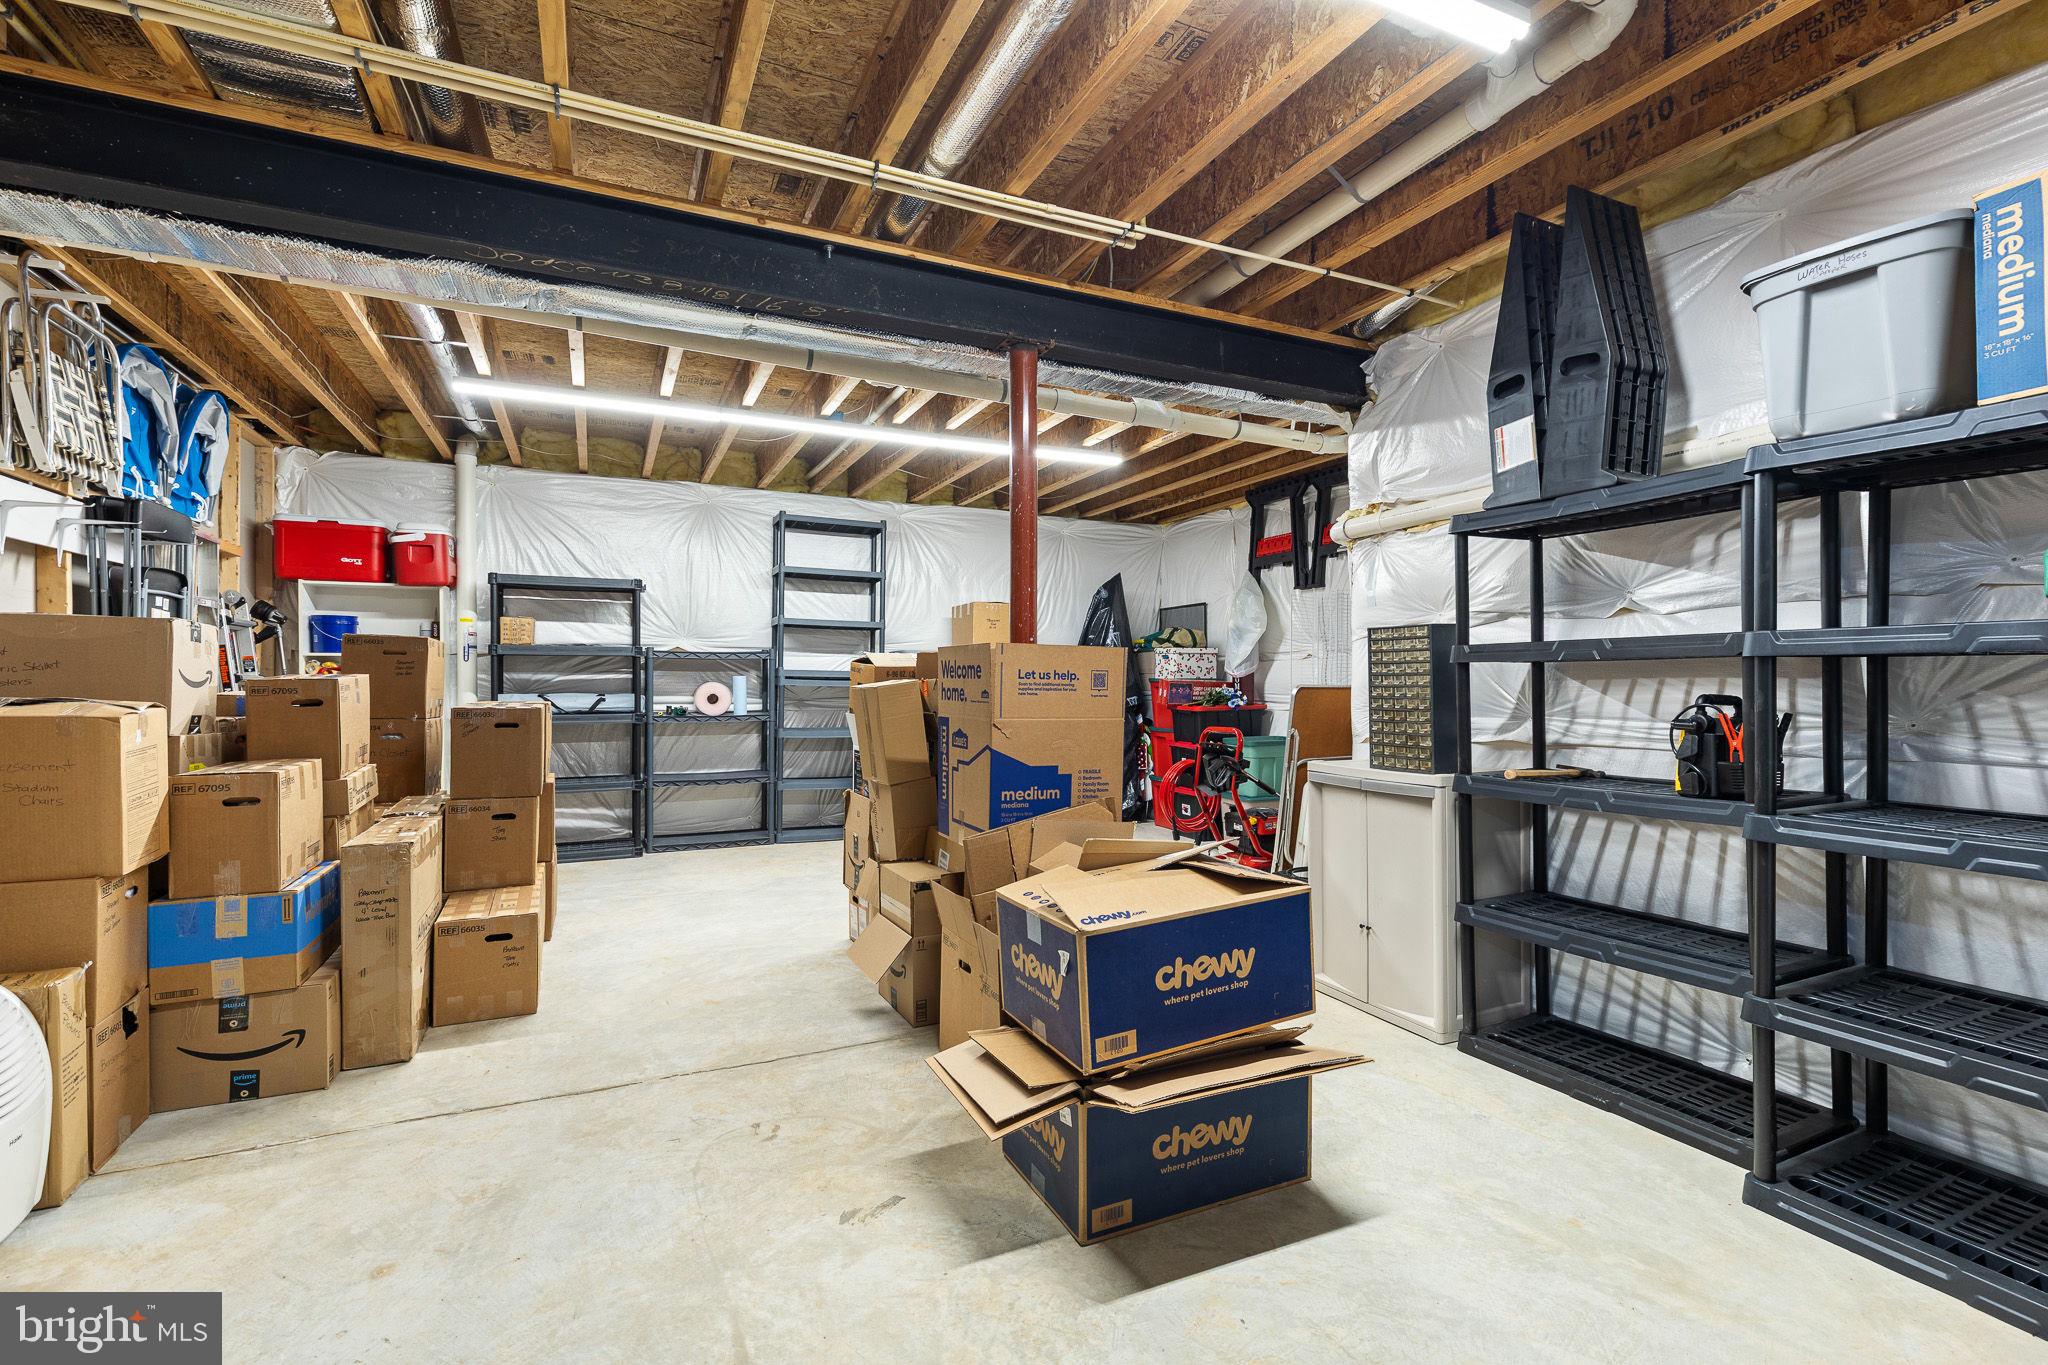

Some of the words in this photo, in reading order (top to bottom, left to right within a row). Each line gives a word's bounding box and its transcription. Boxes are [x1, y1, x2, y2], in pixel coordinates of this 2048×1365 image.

[1626, 96, 1674, 142] 210
[1982, 213, 1993, 260] mediana
[1996, 201, 2036, 337] medium
[941, 659, 982, 680] Welcome
[1018, 668, 1036, 681] Let
[1039, 671, 1051, 681] us
[1053, 669, 1080, 683] help.
[271, 687, 298, 695] 67095
[941, 682, 967, 702] home.
[2, 782, 59, 795] Stadium
[173, 785, 193, 793] REF
[198, 784, 231, 793] 67095
[1001, 786, 1060, 801] medium
[440, 927, 457, 936] REF
[460, 925, 485, 934] 66035
[1011, 943, 1064, 1000] chewy
[1155, 947, 1256, 991] chewy
[1164, 993, 1189, 1006] where
[1191, 990, 1204, 1002] pet
[1205, 984, 1229, 996] lovers
[1231, 979, 1249, 990] shop
[233, 1072, 257, 1082] prime
[1152, 1114, 1252, 1160] chewy
[1160, 1162, 1185, 1175] where
[1186, 1158, 1200, 1170] pet
[1201, 1151, 1225, 1164] lovers
[1226, 1146, 1245, 1158] shop
